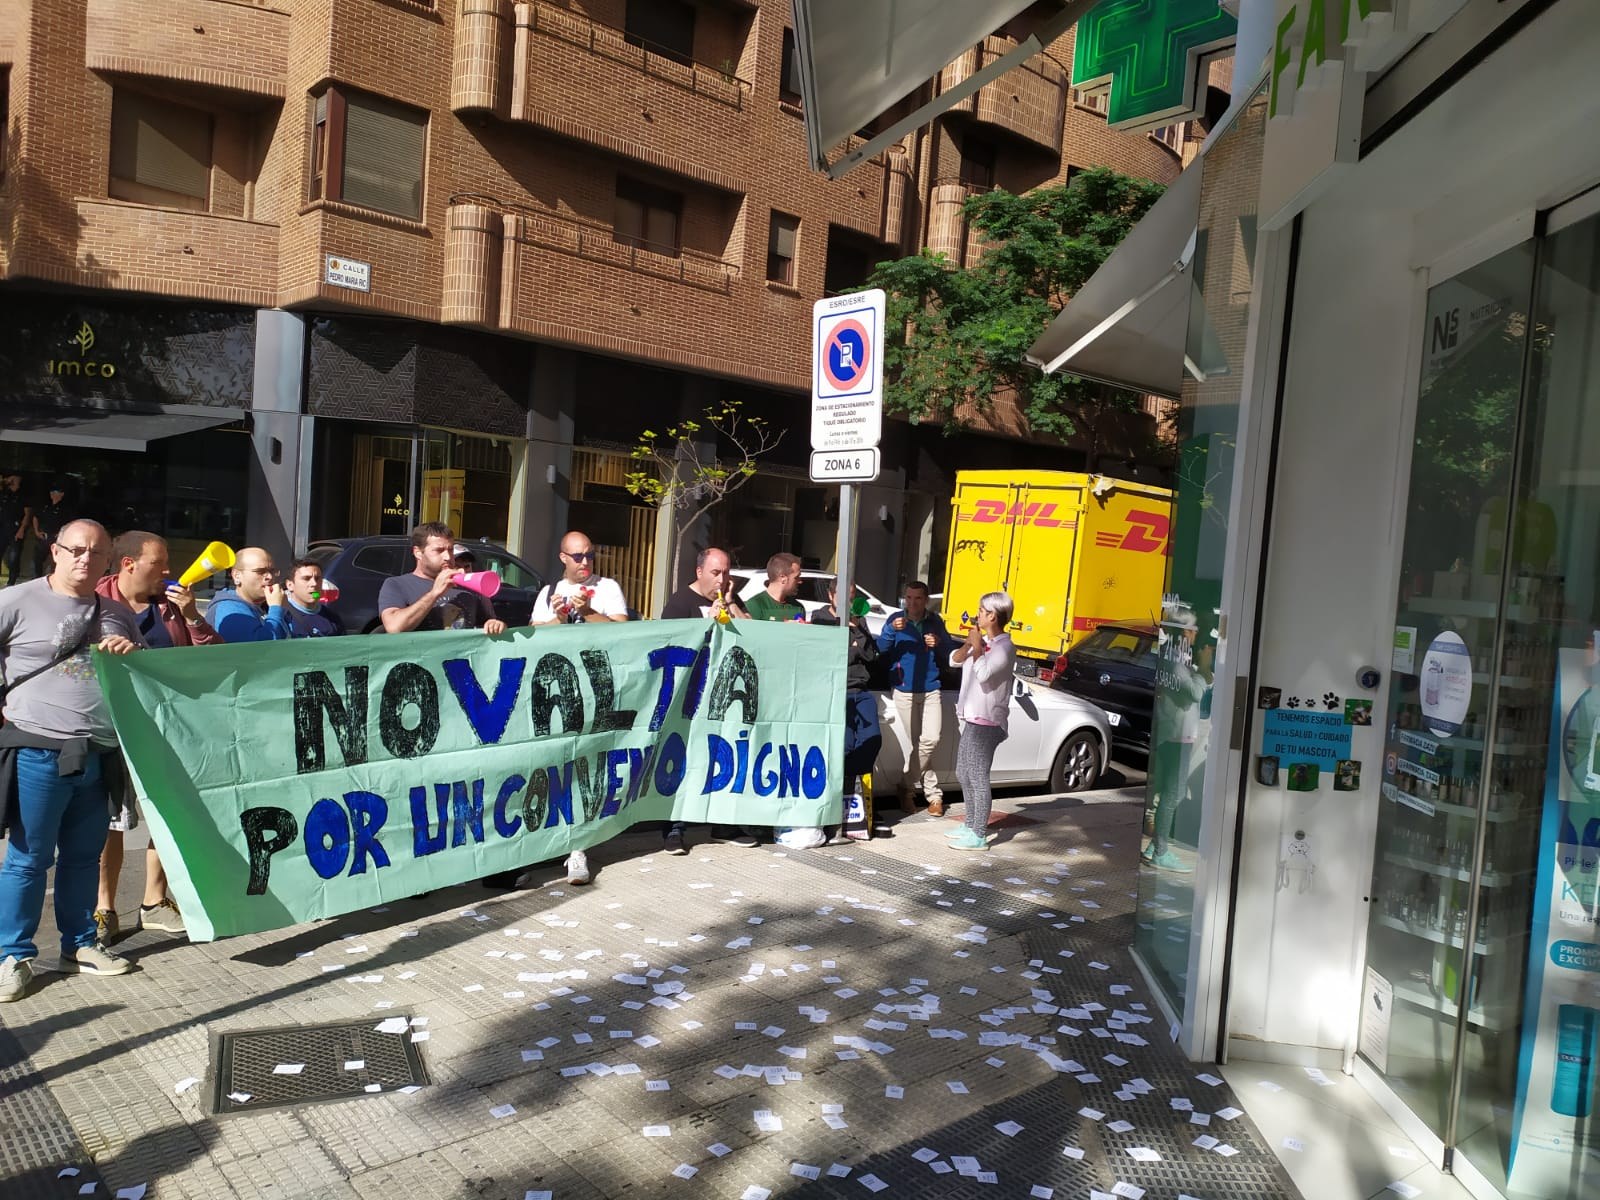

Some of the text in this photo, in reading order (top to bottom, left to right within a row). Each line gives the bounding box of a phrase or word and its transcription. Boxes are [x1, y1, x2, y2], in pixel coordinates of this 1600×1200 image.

[343, 264, 365, 274] CALLE
[824, 458, 861, 471] ZONA 6
[971, 500, 1062, 528] DHL
[1277, 712, 1342, 727] TENEMOS ESPACIO
[1289, 729, 1312, 739] SALUD
[1318, 732, 1350, 743] CUIDADO
[1275, 744, 1337, 758] DE TU MASCOTA
[240, 791, 391, 895] POR
[410, 779, 485, 858] UN
[1560, 910, 1580, 921] Una
